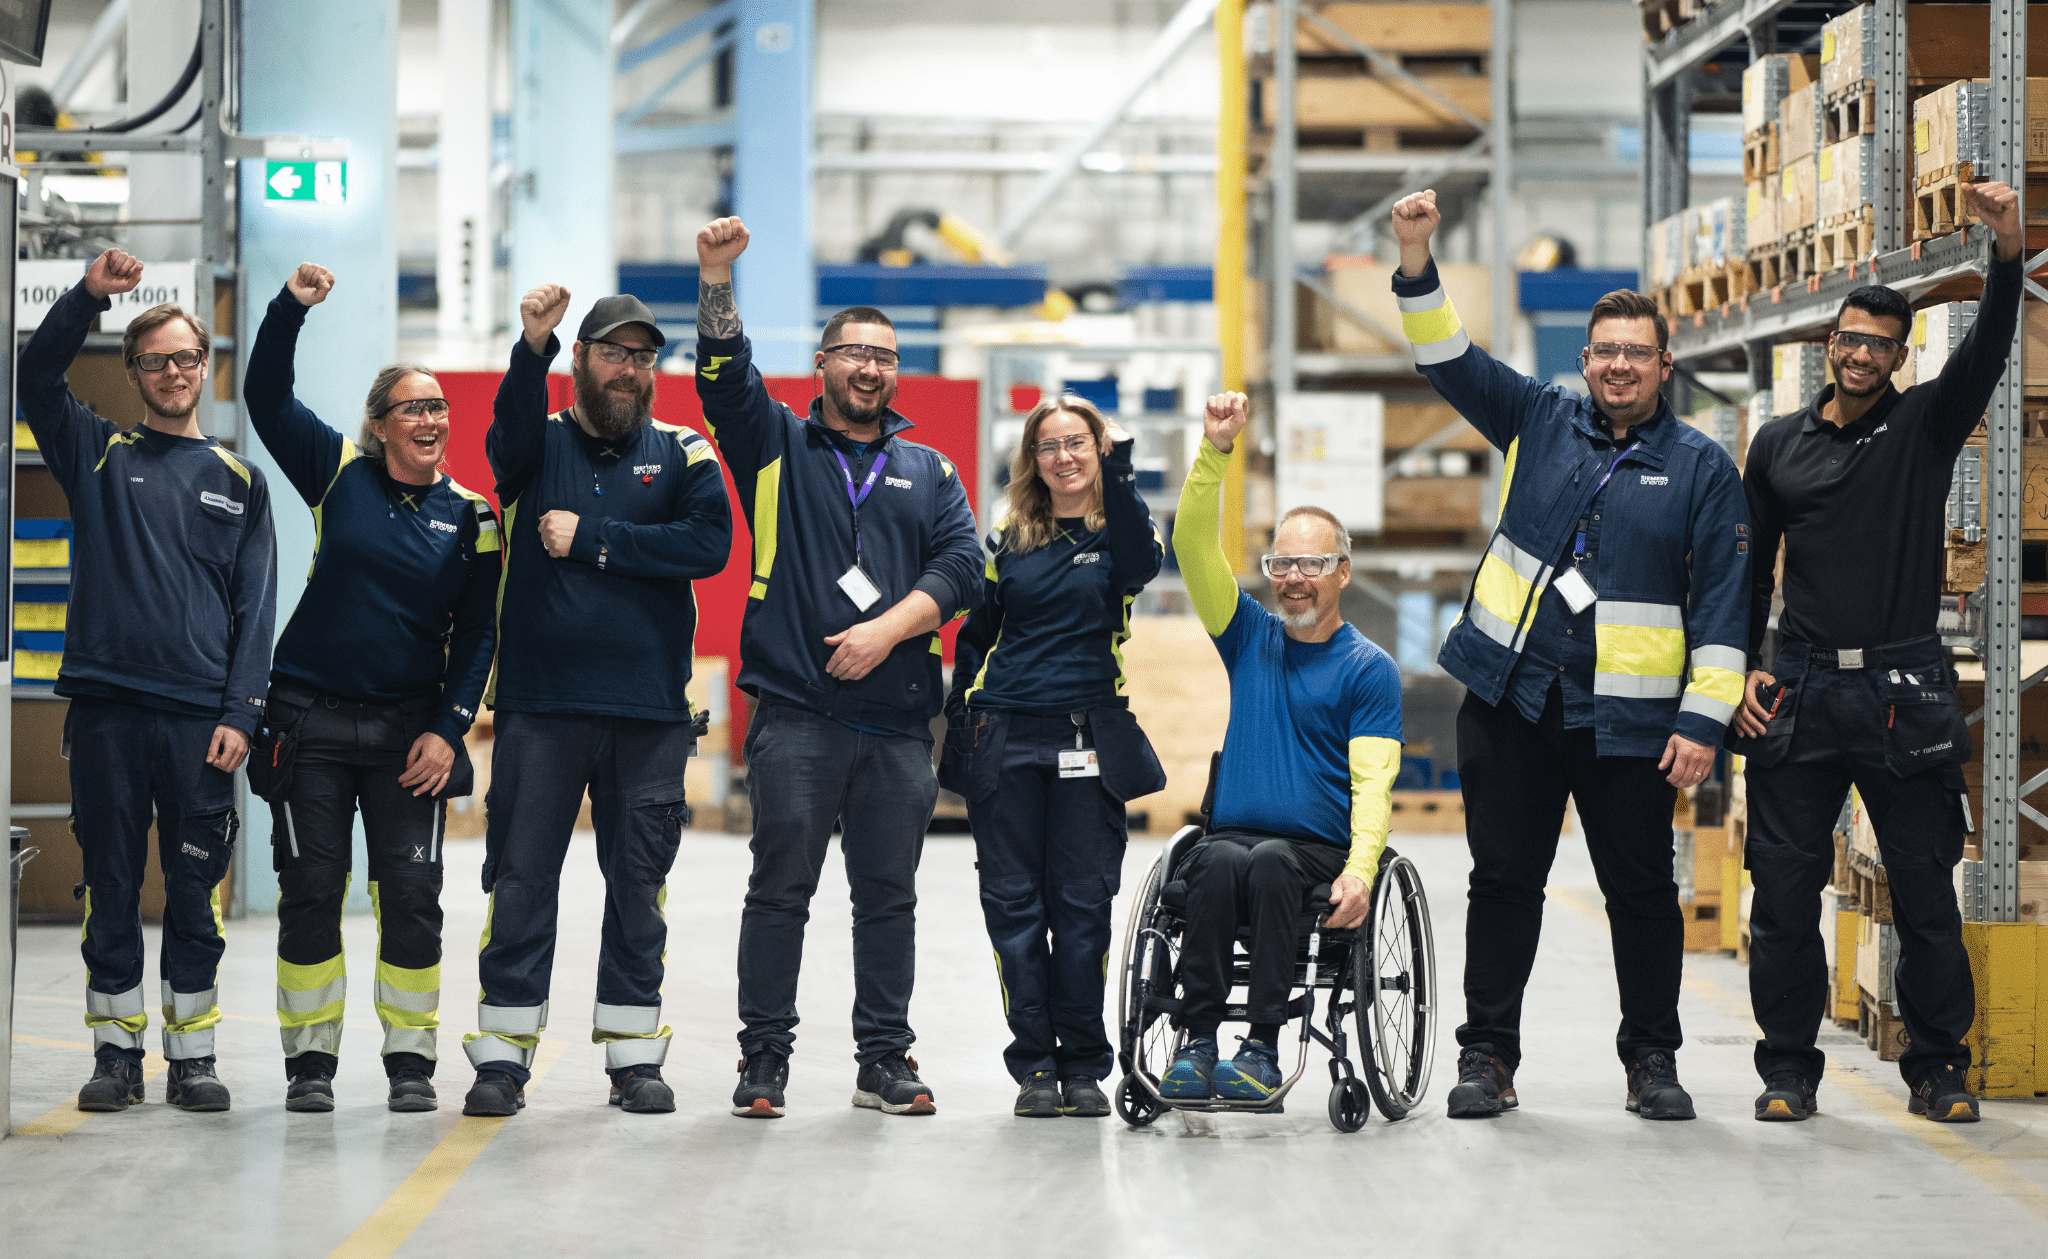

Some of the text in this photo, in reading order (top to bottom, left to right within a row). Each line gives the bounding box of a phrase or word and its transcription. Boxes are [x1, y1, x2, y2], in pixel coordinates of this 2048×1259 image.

[1922, 740, 1953, 754] randstad
[182, 842, 210, 857] SIEMENS
[413, 845, 425, 859] X
